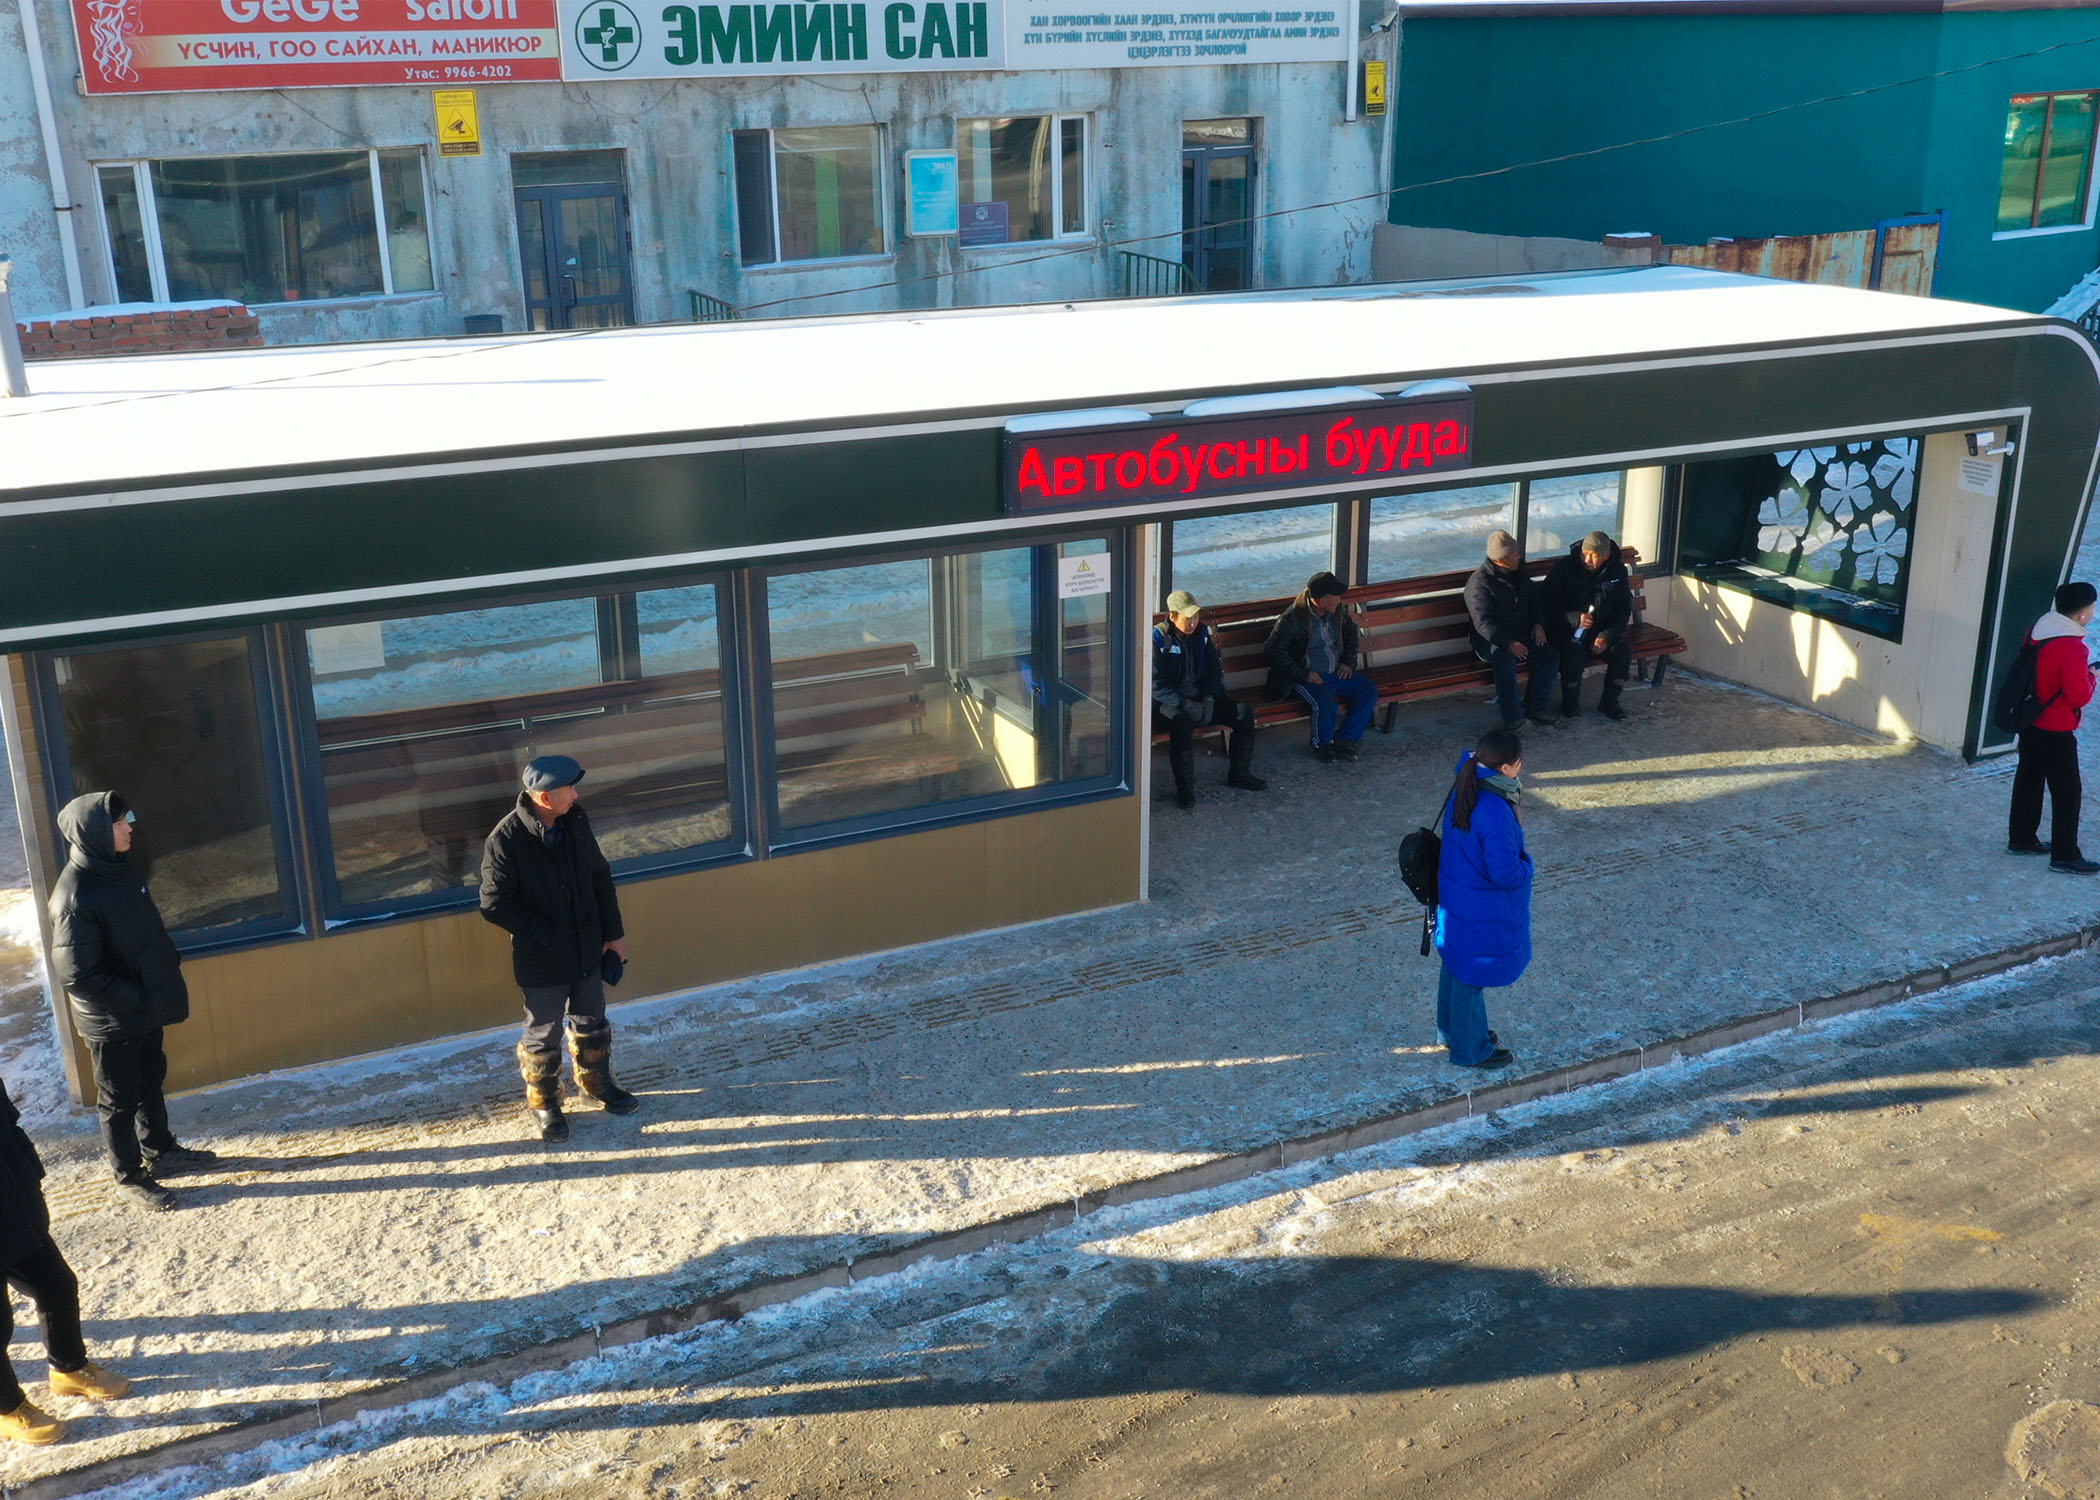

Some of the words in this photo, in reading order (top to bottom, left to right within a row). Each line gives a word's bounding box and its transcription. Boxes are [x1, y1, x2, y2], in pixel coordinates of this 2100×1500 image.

[221, 0, 360, 23] GeGe
[662, 0, 868, 66] ЭМИЙН
[884, 2, 988, 60] САН
[177, 41, 261, 60] ҮСЧИН,
[269, 40, 316, 57] ГОО
[325, 35, 423, 57] САЙХАН,
[432, 36, 542, 55] МАНИКЮР
[404, 67, 440, 80] Утас:
[444, 65, 512, 79] 9966-4202
[1019, 432, 1308, 498] Автобусны
